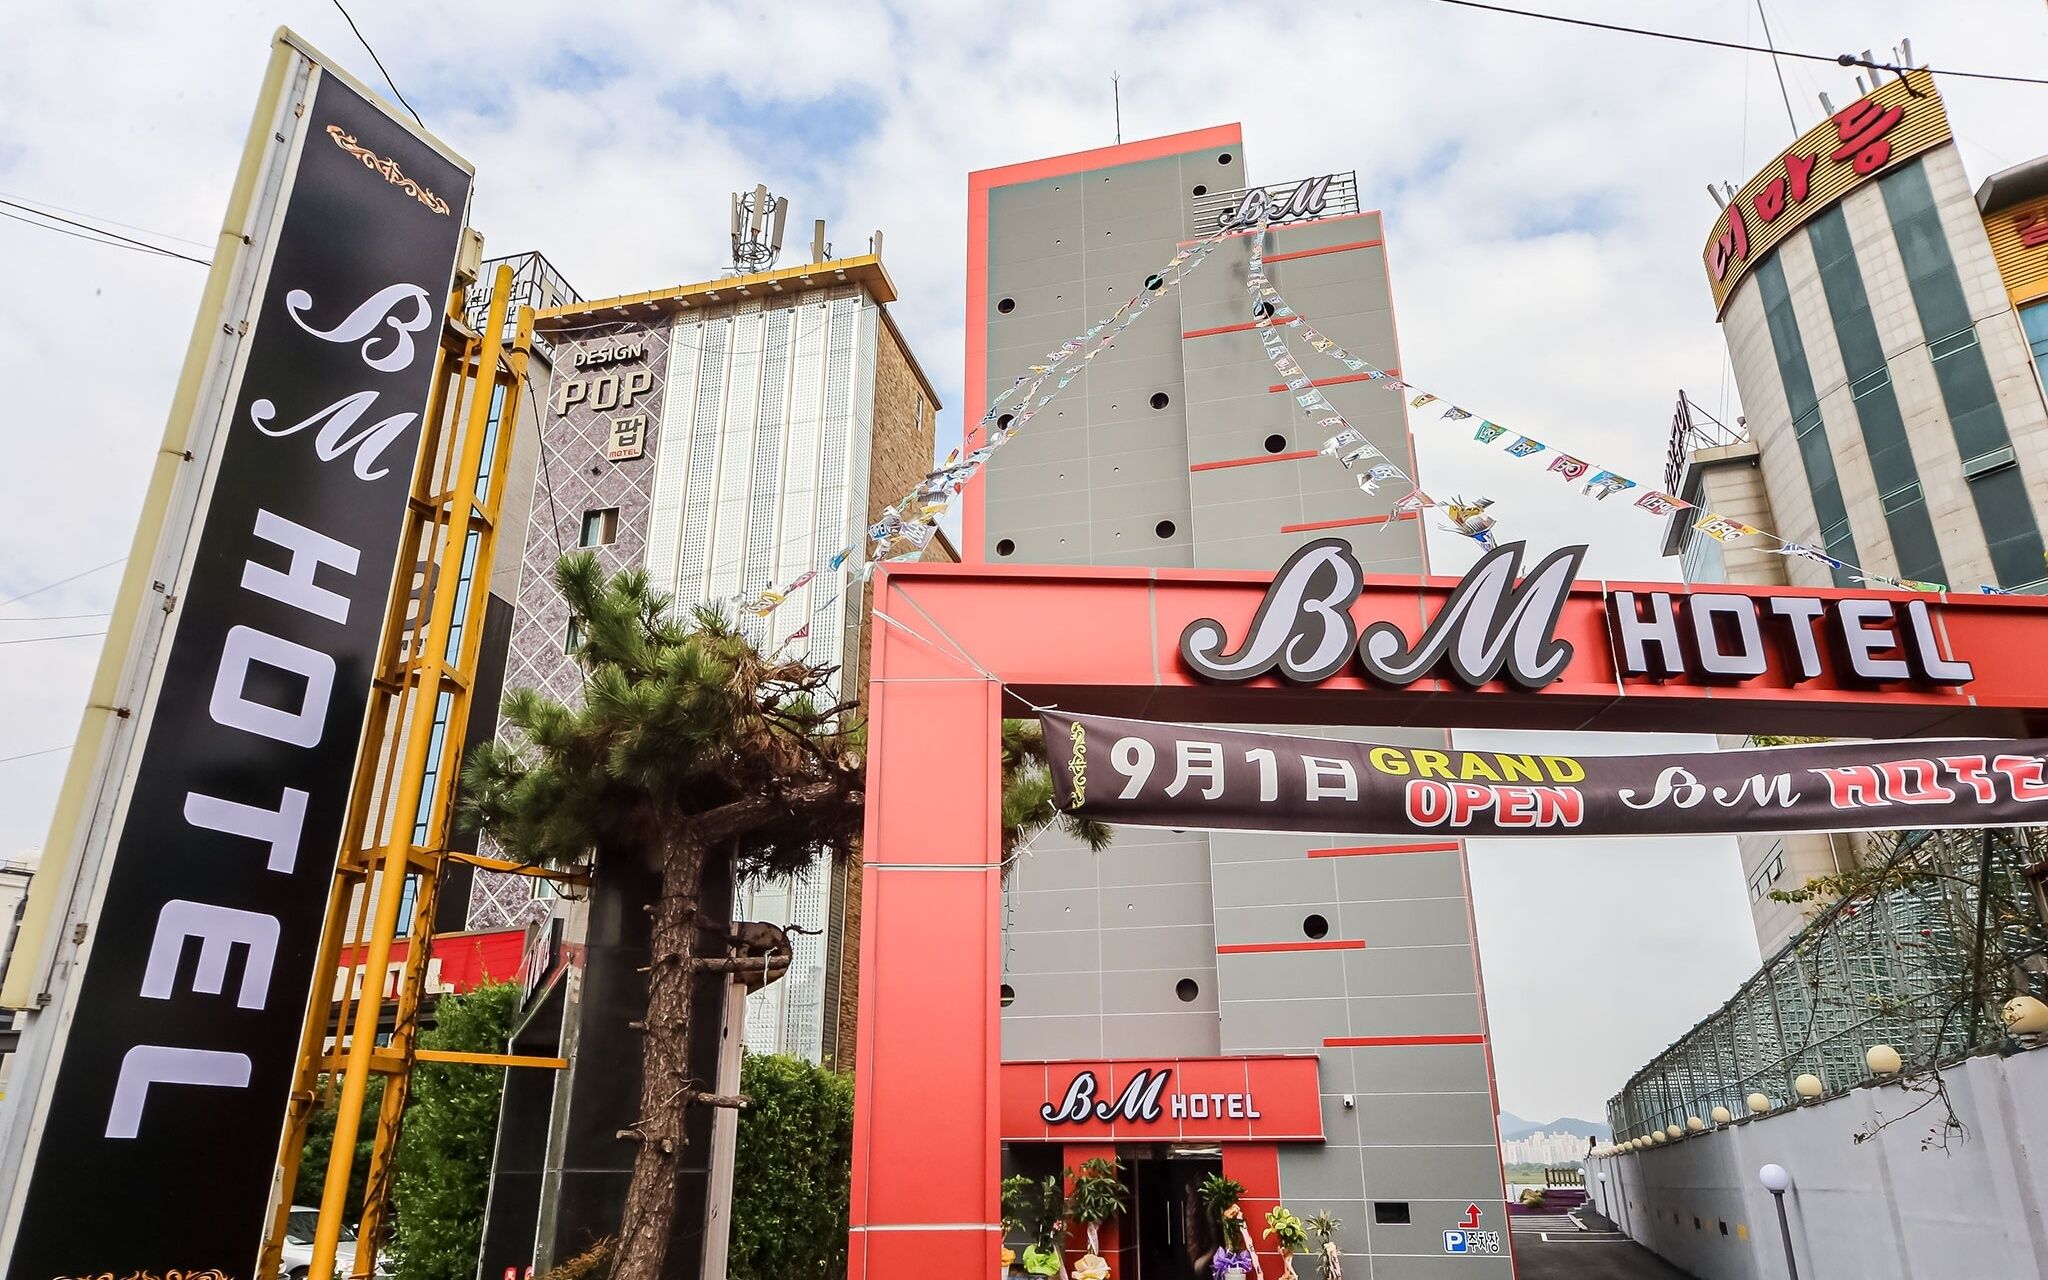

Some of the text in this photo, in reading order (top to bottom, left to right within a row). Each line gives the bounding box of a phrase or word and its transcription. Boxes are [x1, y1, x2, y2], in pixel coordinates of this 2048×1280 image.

[573, 343, 645, 368] DESIGN
[556, 370, 653, 417] POP
[609, 448, 640, 458] MOTEL
[614, 419, 643, 448] 팝
[1178, 537, 1976, 689] BM HOTEL
[104, 282, 433, 1139] BM HOTEL
[1369, 746, 1587, 785] GRAND
[1618, 754, 2048, 811] BM HOTE
[1405, 777, 1585, 828] OPEN
[1040, 1068, 1262, 1126] BM HOTEL
[1467, 1230, 1500, 1253] 주차장
